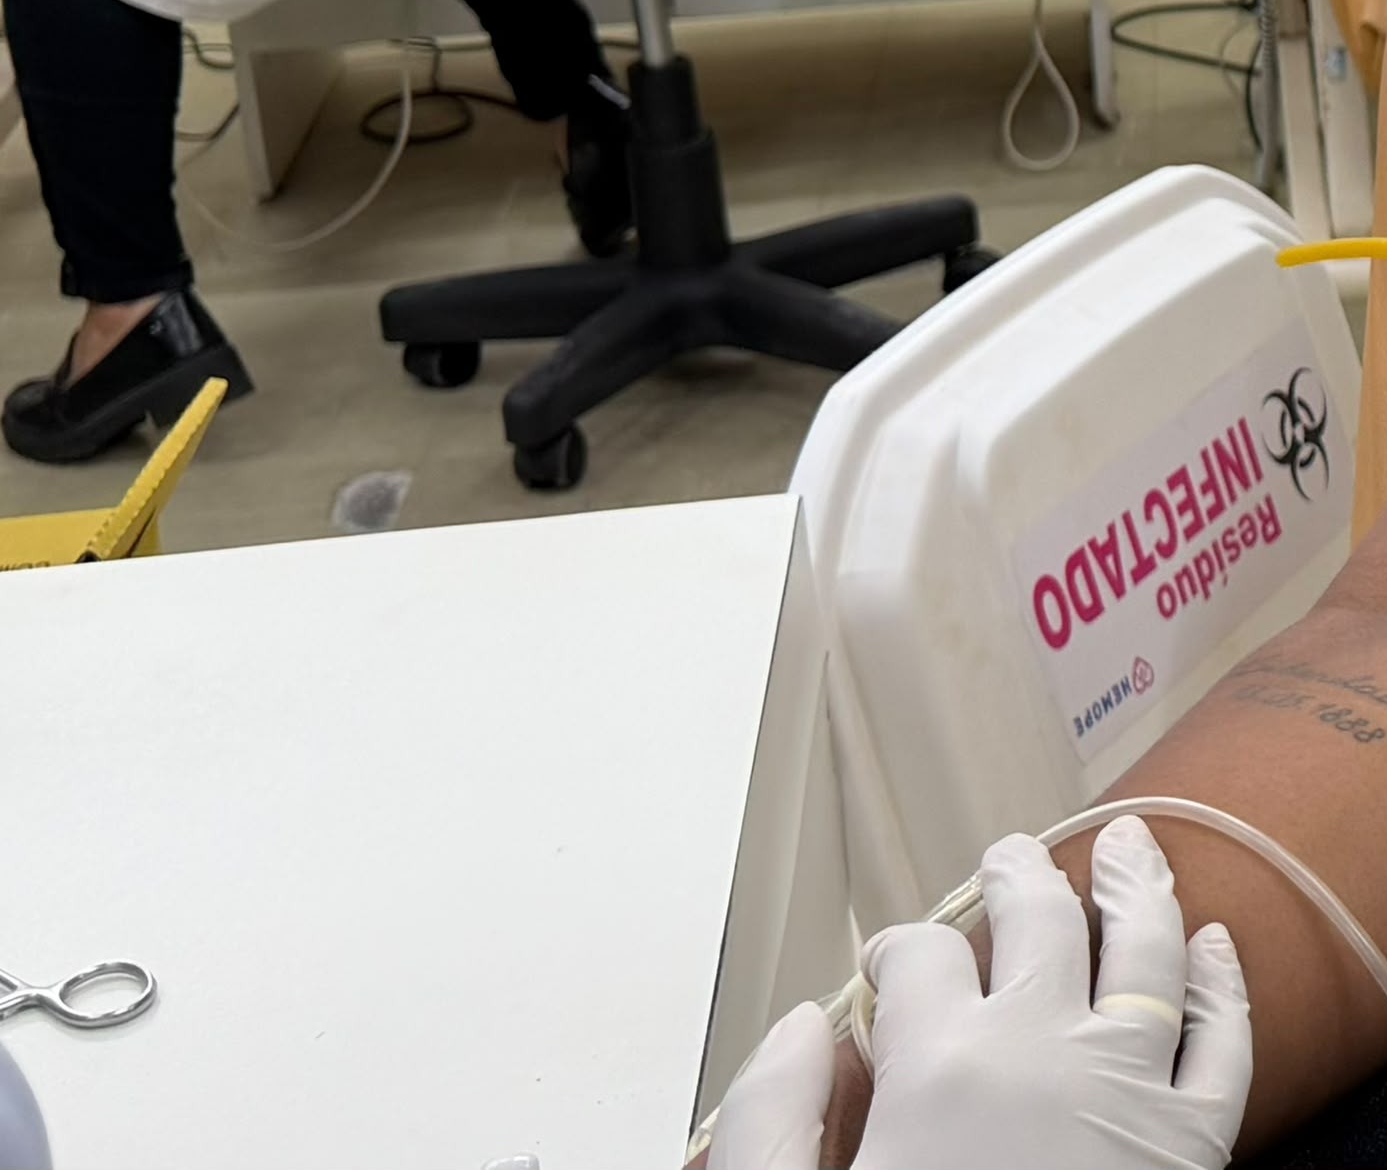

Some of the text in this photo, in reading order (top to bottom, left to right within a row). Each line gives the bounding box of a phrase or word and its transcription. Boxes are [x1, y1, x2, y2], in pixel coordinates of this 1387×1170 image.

[1032, 417, 1264, 652] INFECTADO
[1156, 494, 1283, 620] Resíduo
[1072, 676, 1132, 738] HEMOPE
